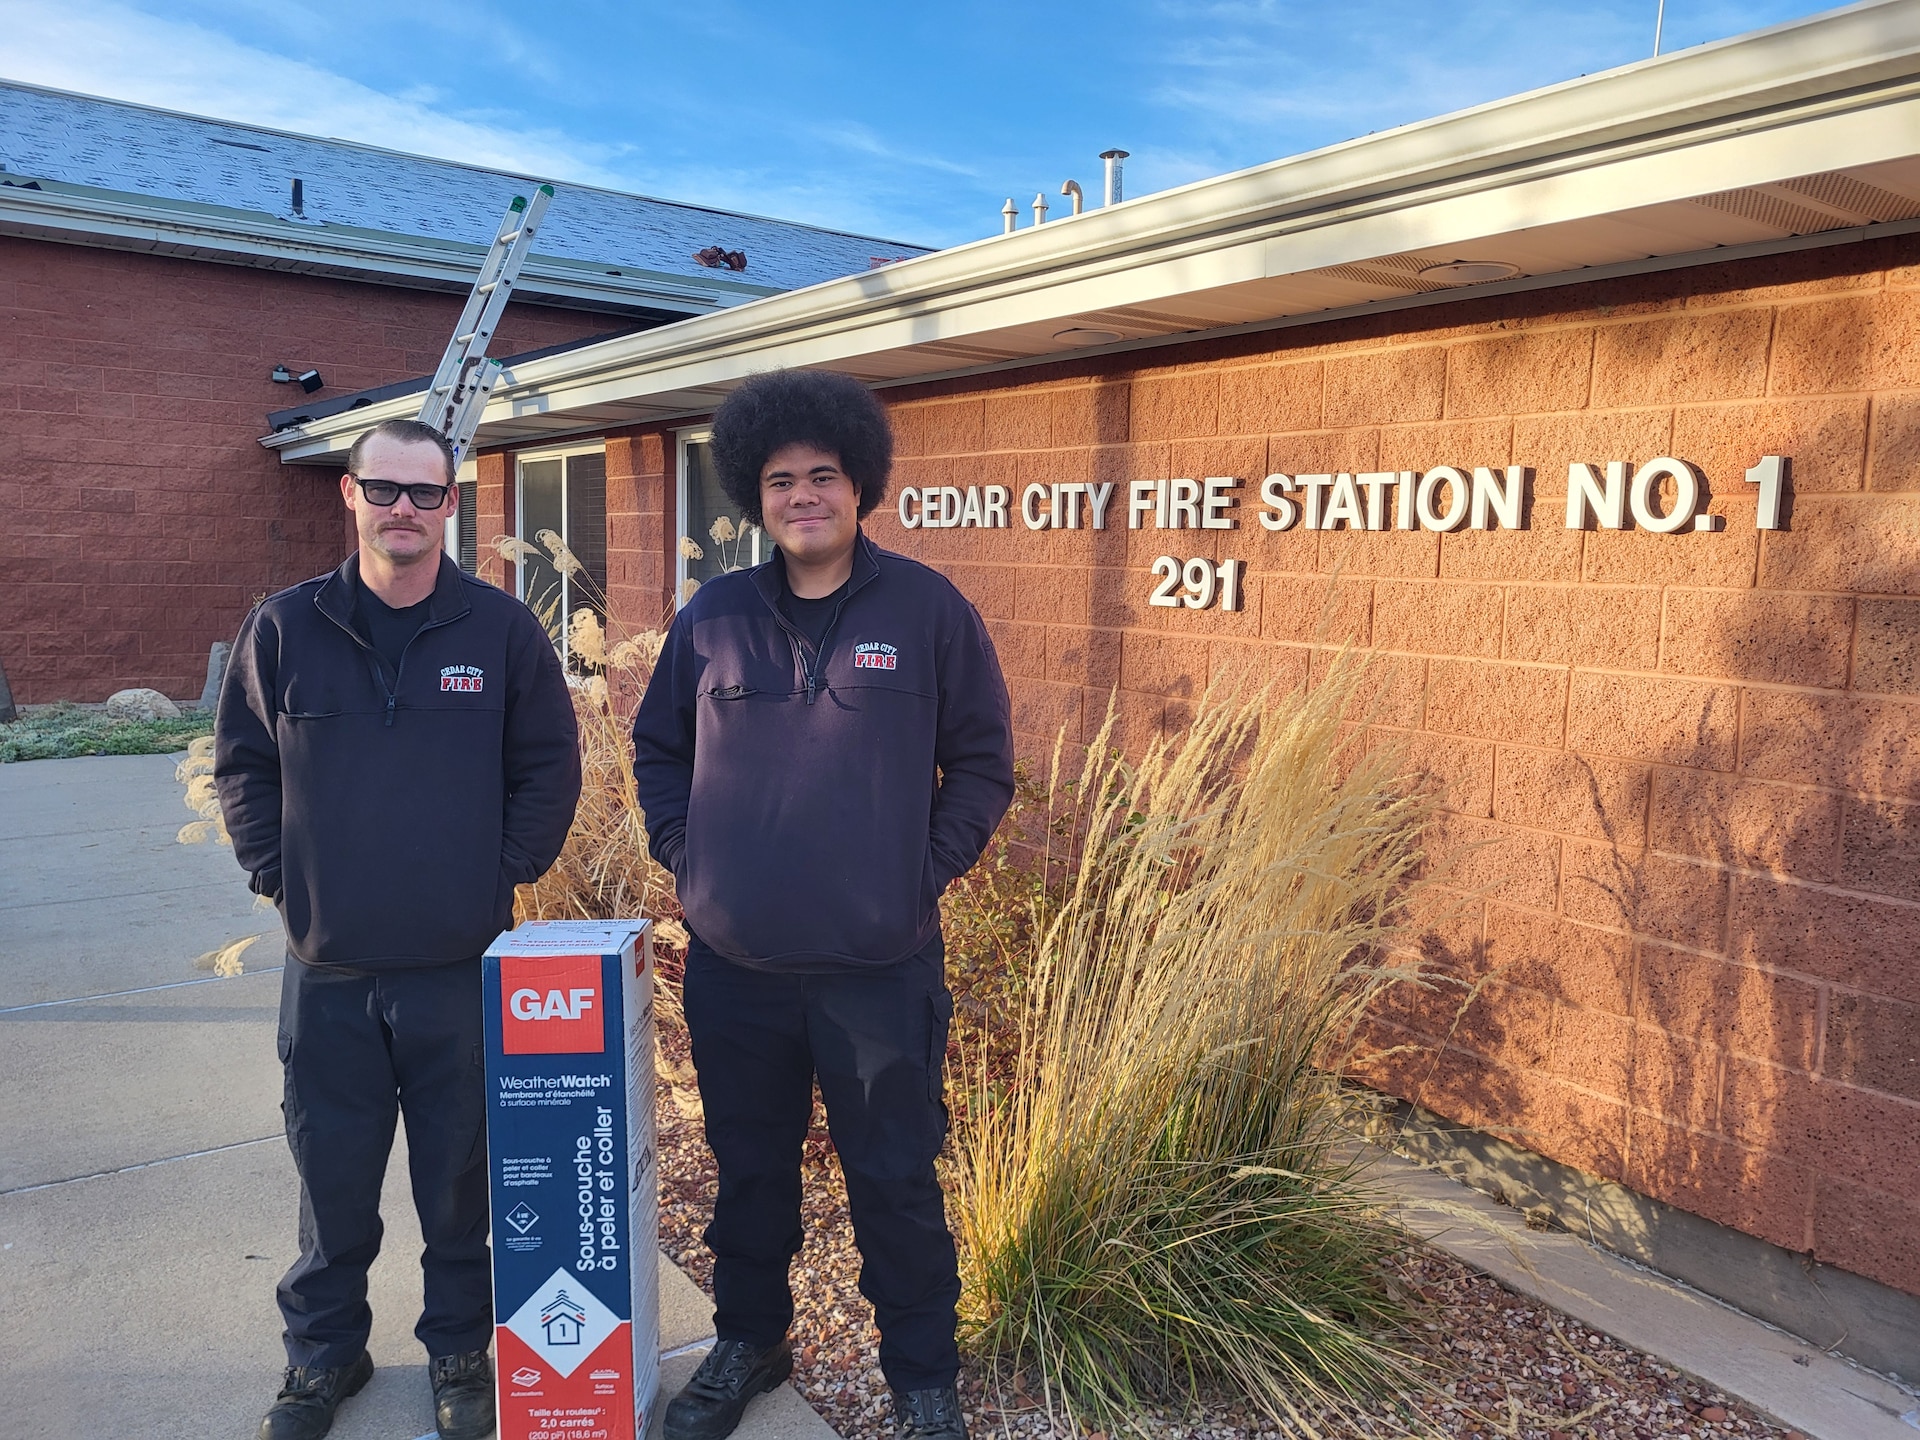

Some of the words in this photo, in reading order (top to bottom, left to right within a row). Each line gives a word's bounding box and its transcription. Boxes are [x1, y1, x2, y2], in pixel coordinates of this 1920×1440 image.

[899, 484, 1010, 530] CEDAR
[1022, 482, 1115, 531] CITY
[1128, 476, 1238, 530] FIRE
[1259, 466, 1524, 532] STATION
[1565, 456, 1717, 534] NO.
[1744, 455, 1786, 531] 1
[1149, 555, 1240, 612] 291
[855, 642, 880, 654] CEDAR
[880, 643, 898, 656] CITY
[854, 653, 897, 670] FIRE
[440, 664, 466, 677] CEDAR
[466, 665, 484, 678] CITY
[440, 676, 484, 692] FIRE
[509, 988, 595, 1021] GAF
[500, 1091, 543, 1099] Membrane
[545, 1089, 596, 1098] d'étanchéité
[507, 1099, 537, 1107] surface
[537, 1098, 572, 1106] minérale
[593, 1106, 614, 1165] coller
[503, 1165, 521, 1173] peler
[520, 1171, 553, 1179] bardeaux
[595, 1171, 615, 1192] et
[573, 1135, 595, 1272] Sous-couche
[597, 1197, 621, 1250] peler
[596, 1255, 617, 1271] à
[559, 1323, 567, 1338] 1
[528, 1408, 551, 1417] Taille
[552, 1408, 565, 1416] du
[540, 1418, 557, 1429] 2,0
[559, 1416, 595, 1428] carrés
[528, 1431, 549, 1440] (200
